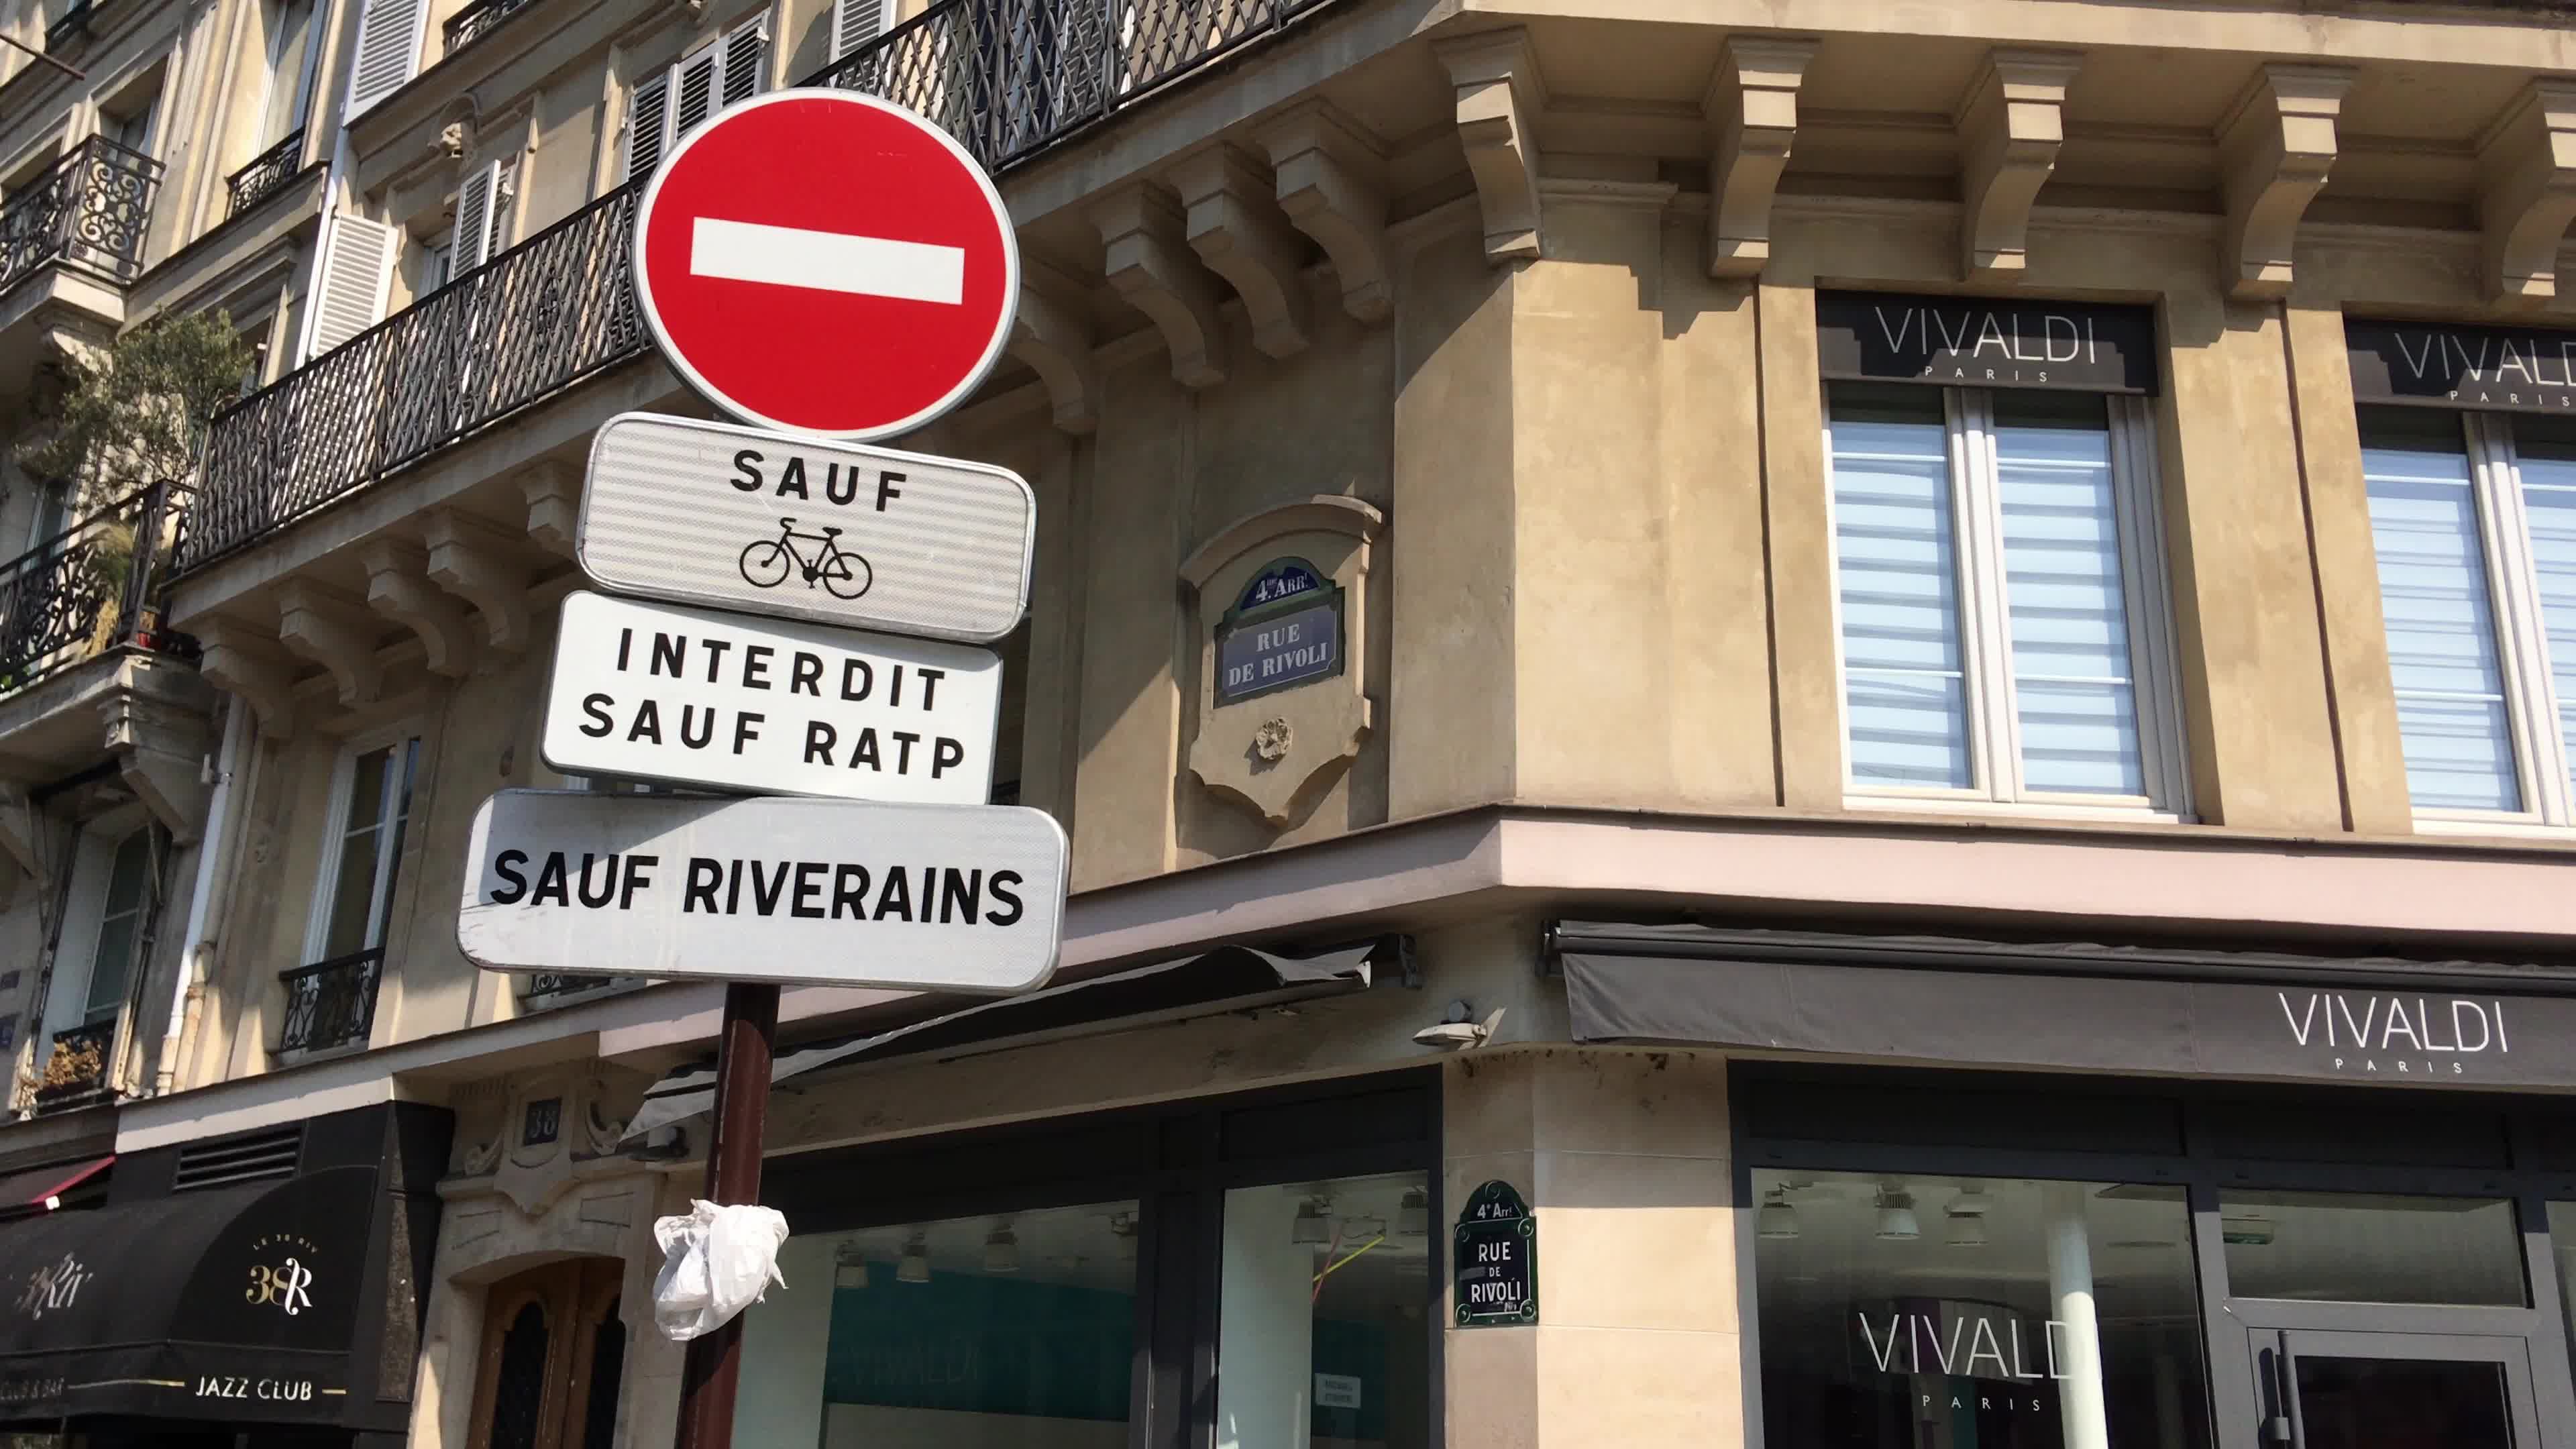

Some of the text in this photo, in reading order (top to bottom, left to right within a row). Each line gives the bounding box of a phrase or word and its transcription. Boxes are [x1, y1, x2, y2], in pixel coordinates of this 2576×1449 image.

[1875, 307, 2096, 364] VIVALDI
[1924, 366, 2049, 383] PARIS
[2449, 390, 2570, 407] PARIS
[730, 449, 906, 512] SAUF
[1256, 623, 1300, 652] RUE
[616, 628, 945, 711] INTERDIT
[1228, 642, 1328, 687] DE RIVOLI
[579, 693, 964, 779] SAUF RATP
[490, 849, 1023, 926] SAUF RIVERAINS
[2278, 992, 2508, 1053] VIVALDI
[2334, 1057, 2463, 1074] PARIS
[1478, 1241, 1511, 1262] RUE
[1489, 1267, 1501, 1278] DE
[1470, 1281, 1521, 1303] RIVOLI
[195, 1376, 312, 1401] JAZZ CLUB
[1922, 1395, 2041, 1411] PARIS
